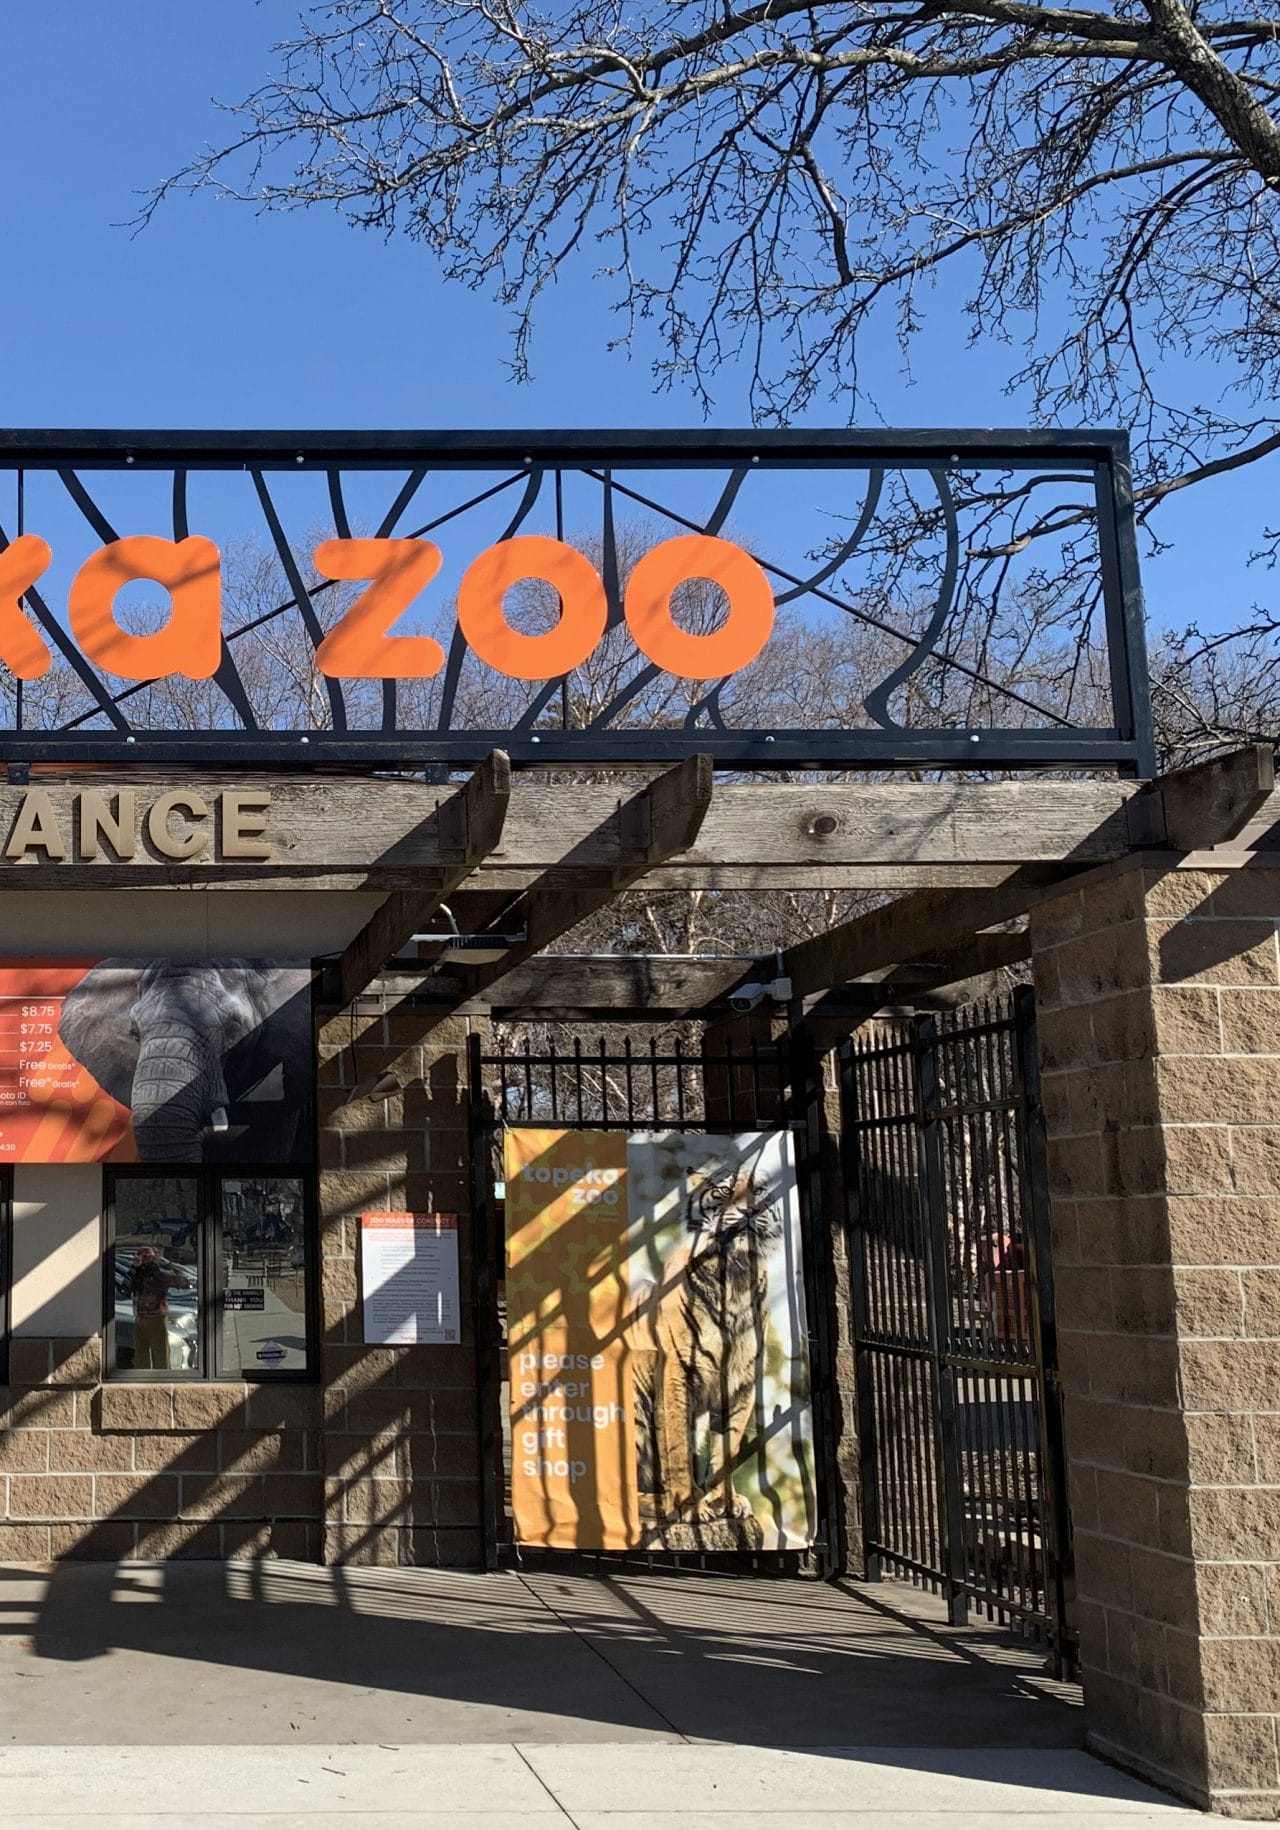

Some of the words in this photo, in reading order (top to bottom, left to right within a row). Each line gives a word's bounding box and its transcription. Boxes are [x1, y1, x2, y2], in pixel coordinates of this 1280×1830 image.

[314, 535, 776, 680] zoo
[21, 1005, 55, 1017] $8.75
[20, 1023, 52, 1035] $7.75
[19, 1041, 53, 1053] $7.25
[19, 1059, 47, 1070] Free
[17, 1091, 26, 1100] ID
[519, 1162, 620, 1188] topeka
[572, 1188, 618, 1205] zoo
[519, 1350, 605, 1376] please
[520, 1378, 589, 1398] enter
[522, 1401, 625, 1429] through
[522, 1426, 565, 1454] gift
[523, 1455, 587, 1484] shop
